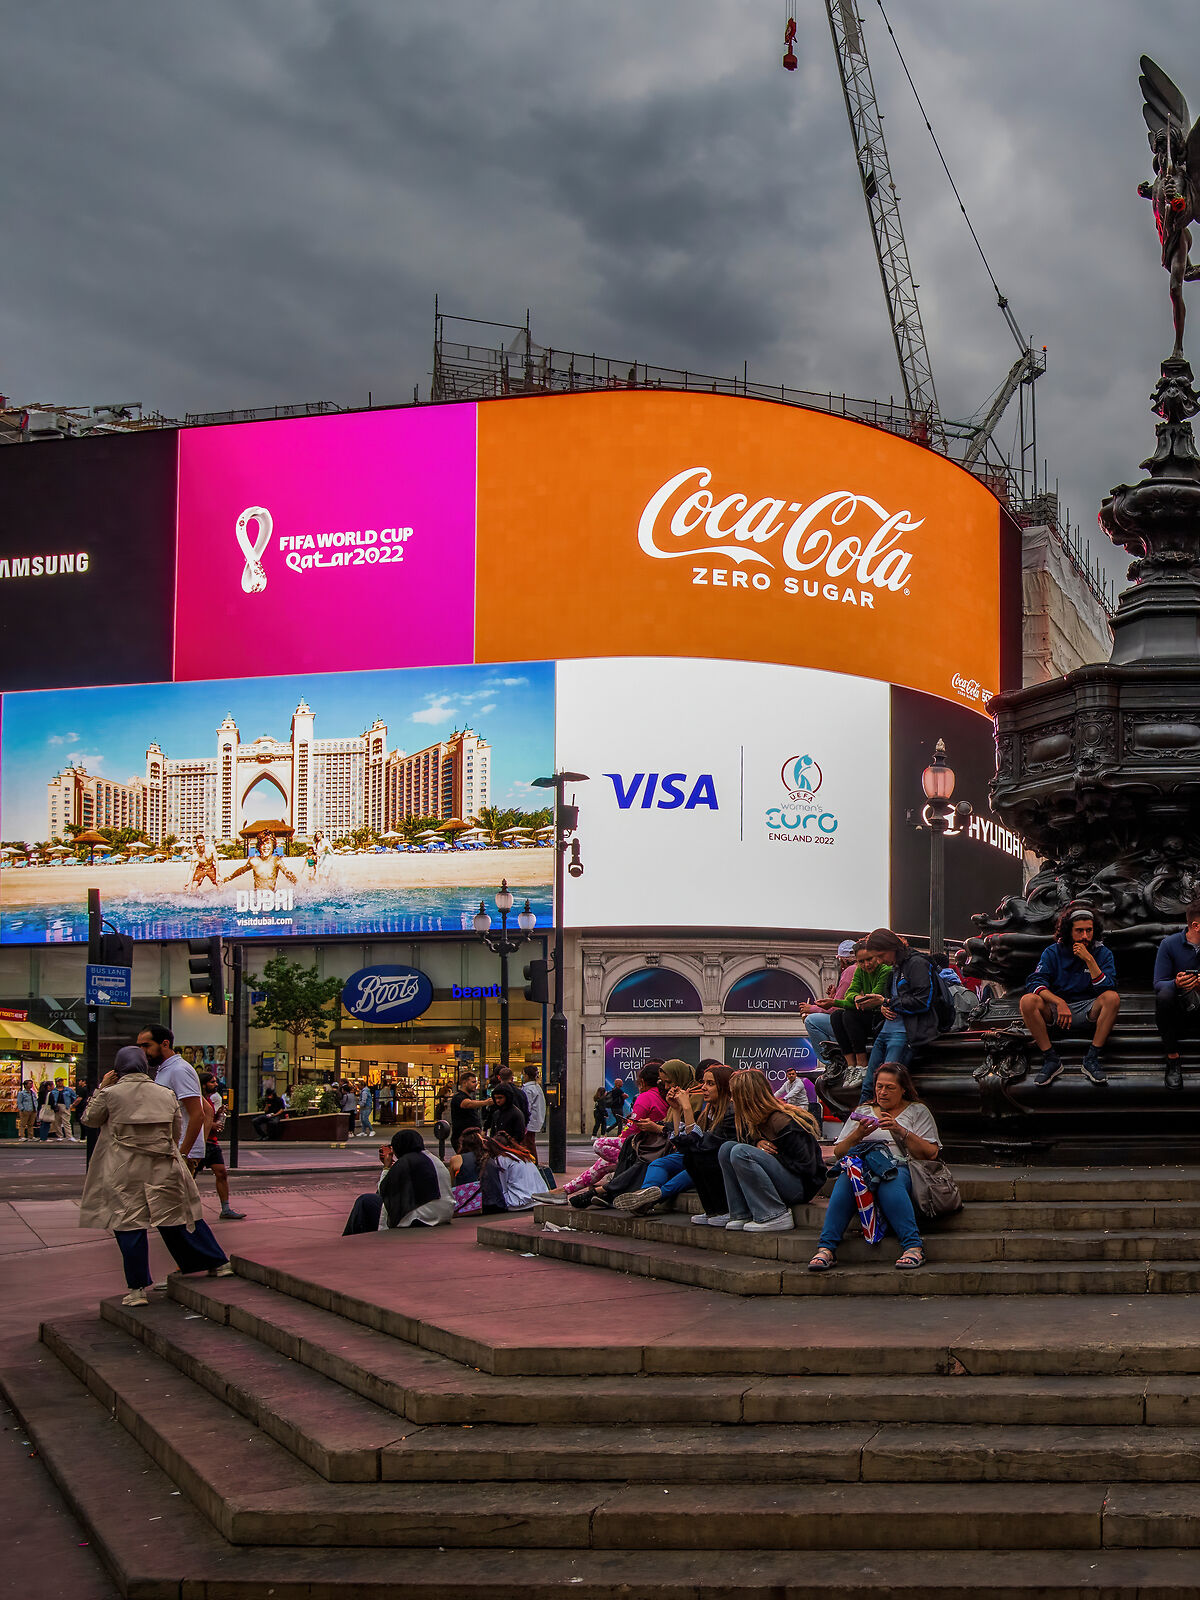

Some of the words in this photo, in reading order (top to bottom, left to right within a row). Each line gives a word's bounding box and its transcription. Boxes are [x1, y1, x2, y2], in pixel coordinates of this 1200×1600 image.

[637, 466, 926, 592] Coca-Cola
[279, 535, 315, 551] FIFA
[316, 530, 378, 549] WORLD
[380, 527, 413, 543] CUP
[0, 552, 89, 579] AMSUNG
[692, 567, 771, 590] ZERO
[784, 577, 875, 609] SUGAR
[951, 672, 980, 698] Coca-Cola
[602, 773, 719, 810] VISA
[789, 792, 813, 802] UEFA
[780, 803, 823, 813] women's
[768, 832, 813, 843] ENGLAND
[814, 835, 835, 845] 2022
[968, 815, 1023, 860] HYUNDAI
[236, 888, 294, 914] DUBAI
[237, 916, 293, 927] visitdubai.com
[108, 968, 127, 976] LANE
[109, 989, 129, 997] BOTH
[350, 974, 419, 1013] Boots
[632, 999, 674, 1008] LUCENT
[747, 1000, 788, 1009] LUCENT
[48, 1010, 77, 1019] KOPPEL
[38, 1042, 51, 1050] HOT
[51, 1043, 64, 1051] DOG
[613, 1047, 651, 1058] PRIME
[732, 1047, 810, 1058] ILLUMINATED
[739, 1059, 753, 1069] by
[755, 1061, 769, 1070] an
[765, 1070, 786, 1081] ICO
